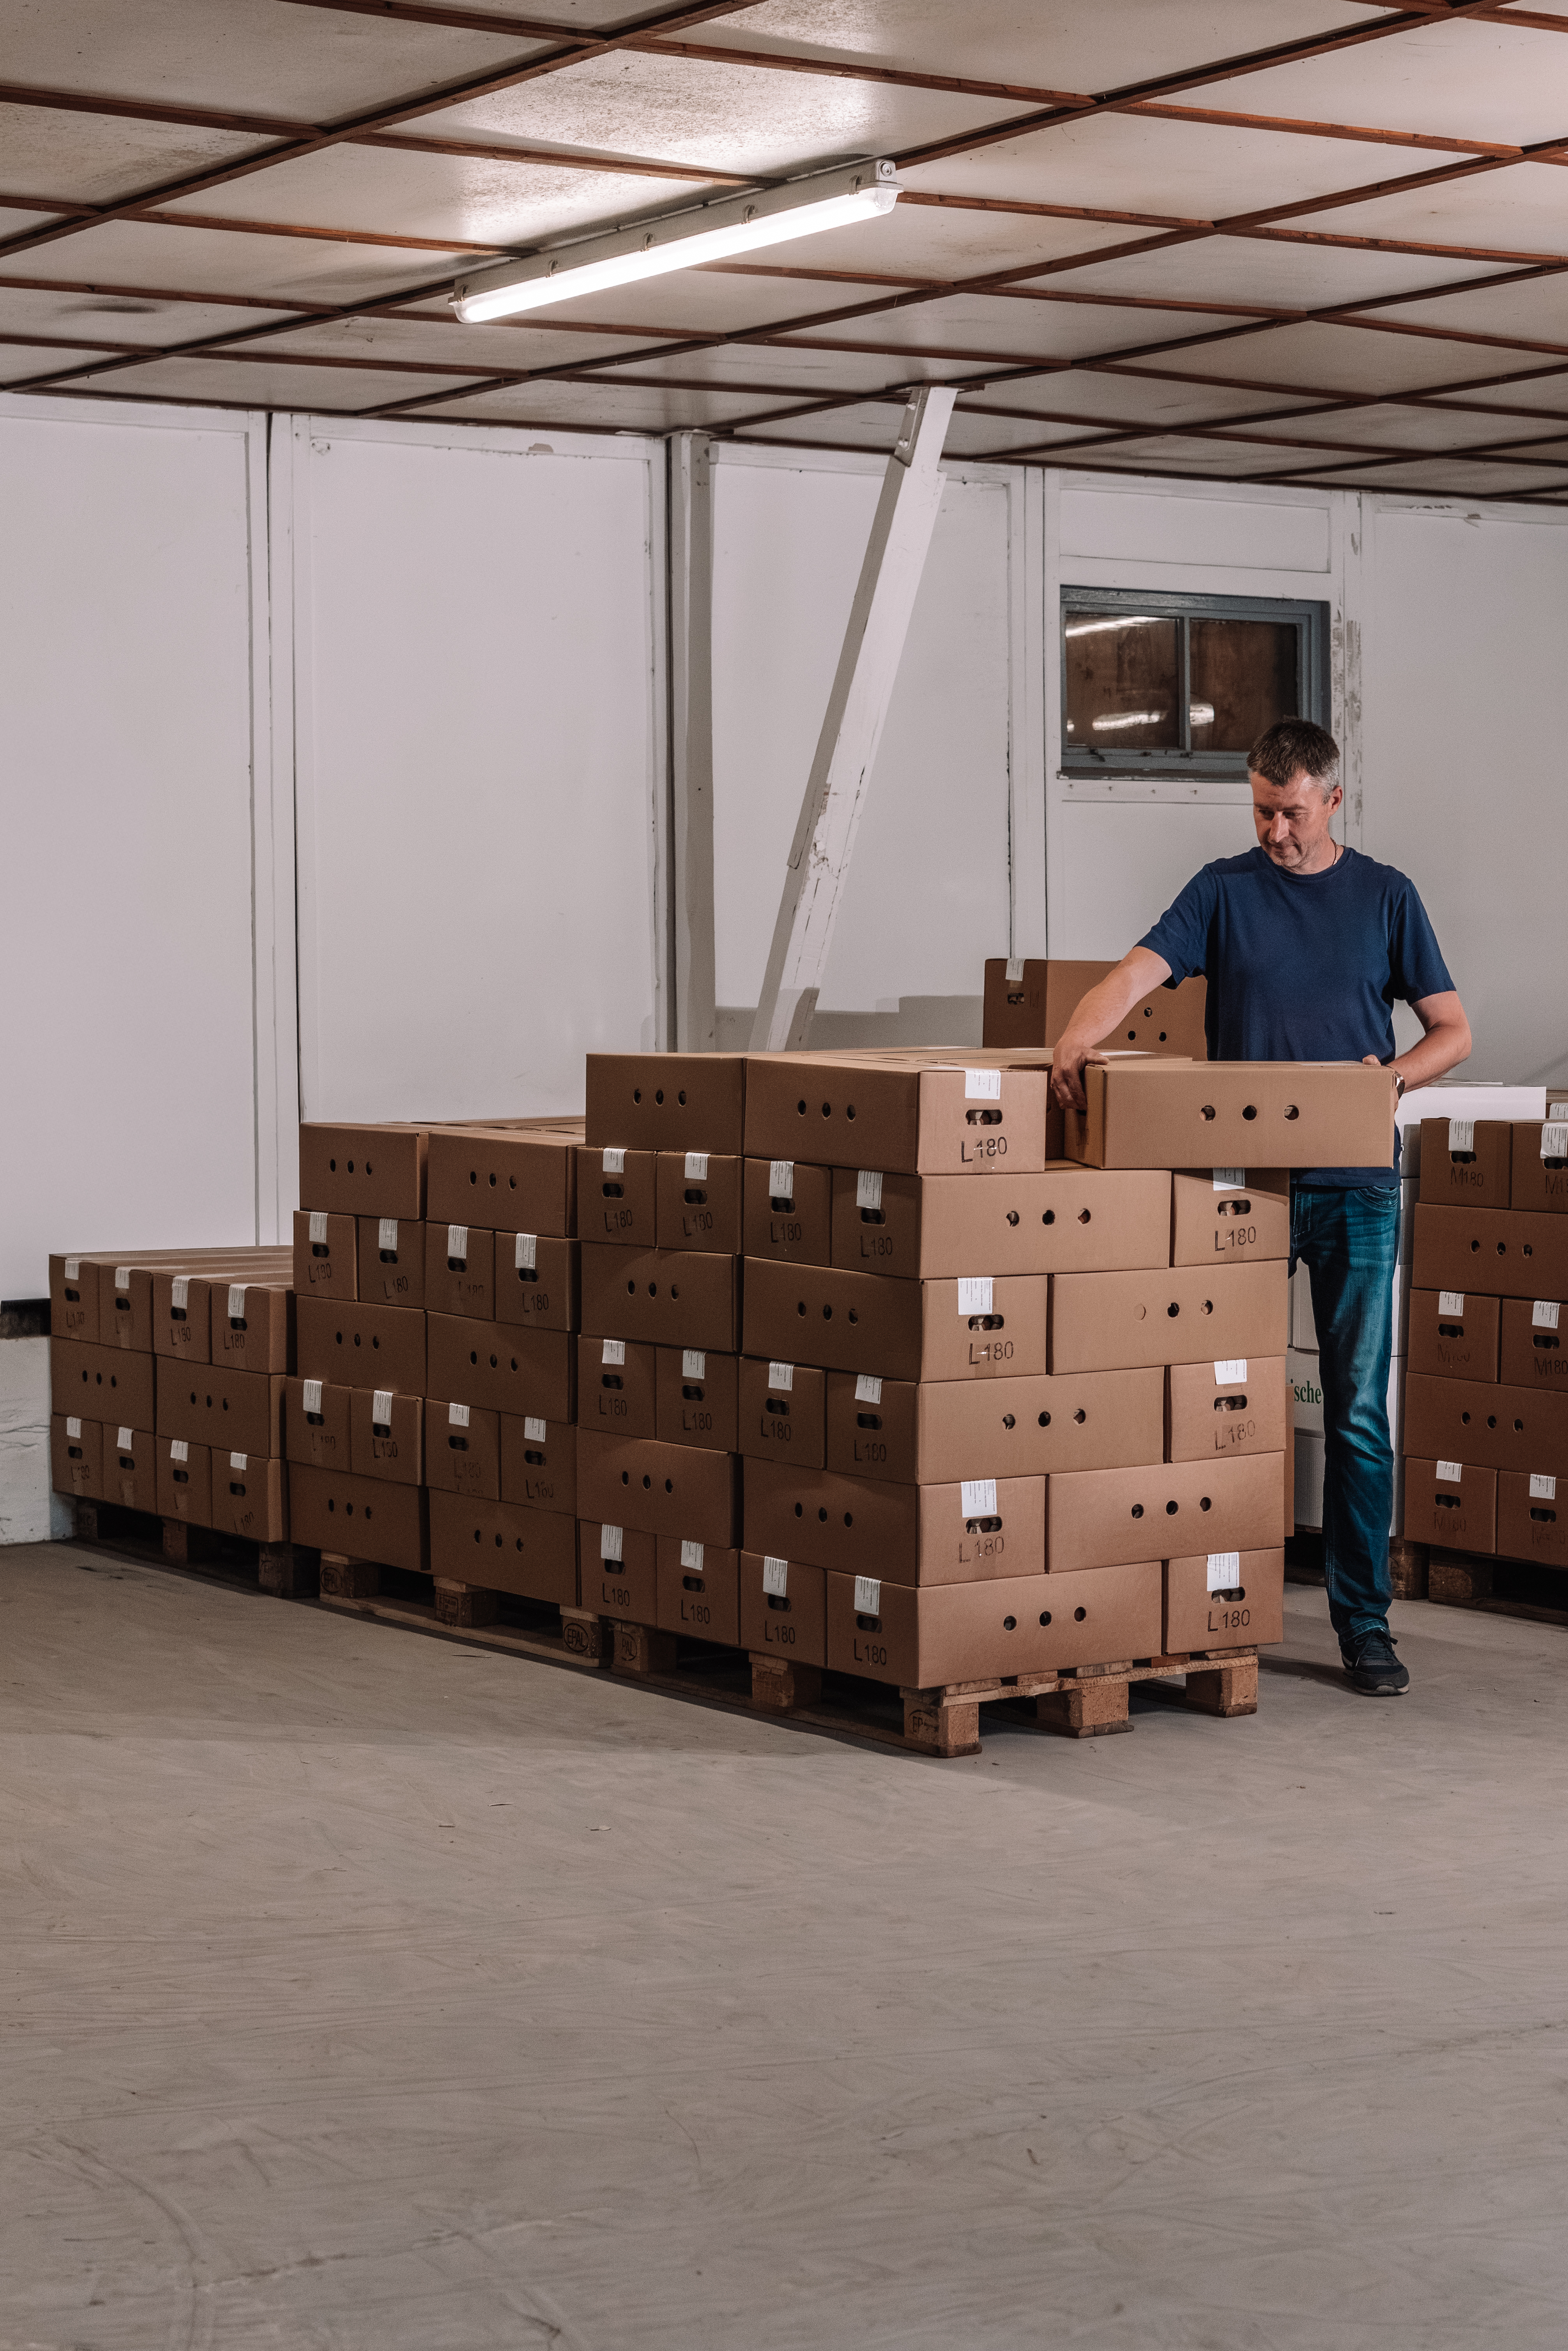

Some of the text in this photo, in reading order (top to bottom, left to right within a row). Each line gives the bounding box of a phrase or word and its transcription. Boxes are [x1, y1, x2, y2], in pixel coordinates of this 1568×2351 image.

[961, 1137, 1007, 1162] L180
[1451, 1166, 1484, 1187] M180
[605, 1209, 633, 1232] L180
[683, 1212, 712, 1237] L180
[770, 1222, 802, 1243] L180
[1215, 1226, 1256, 1251] L180
[861, 1235, 893, 1258] L180
[384, 1276, 408, 1299] L180
[523, 1293, 549, 1313] L180
[171, 1327, 191, 1346] L180
[224, 1330, 245, 1350] L180
[969, 1341, 1014, 1365] L180
[1534, 1356, 1568, 1376] M180
[1290, 1378, 1322, 1404] sche
[599, 1394, 627, 1416] L180
[682, 1409, 712, 1431] L180
[761, 1415, 791, 1442] L180
[1214, 1420, 1256, 1451] L180
[854, 1440, 886, 1462] L180
[959, 1536, 1004, 1563] L180
[603, 1582, 630, 1607] L180
[681, 1599, 710, 1624] L180
[1208, 1609, 1250, 1632] L180
[567, 1628, 585, 1649] EPAL
[765, 1620, 795, 1644] L180
[854, 1638, 887, 1666] L180
